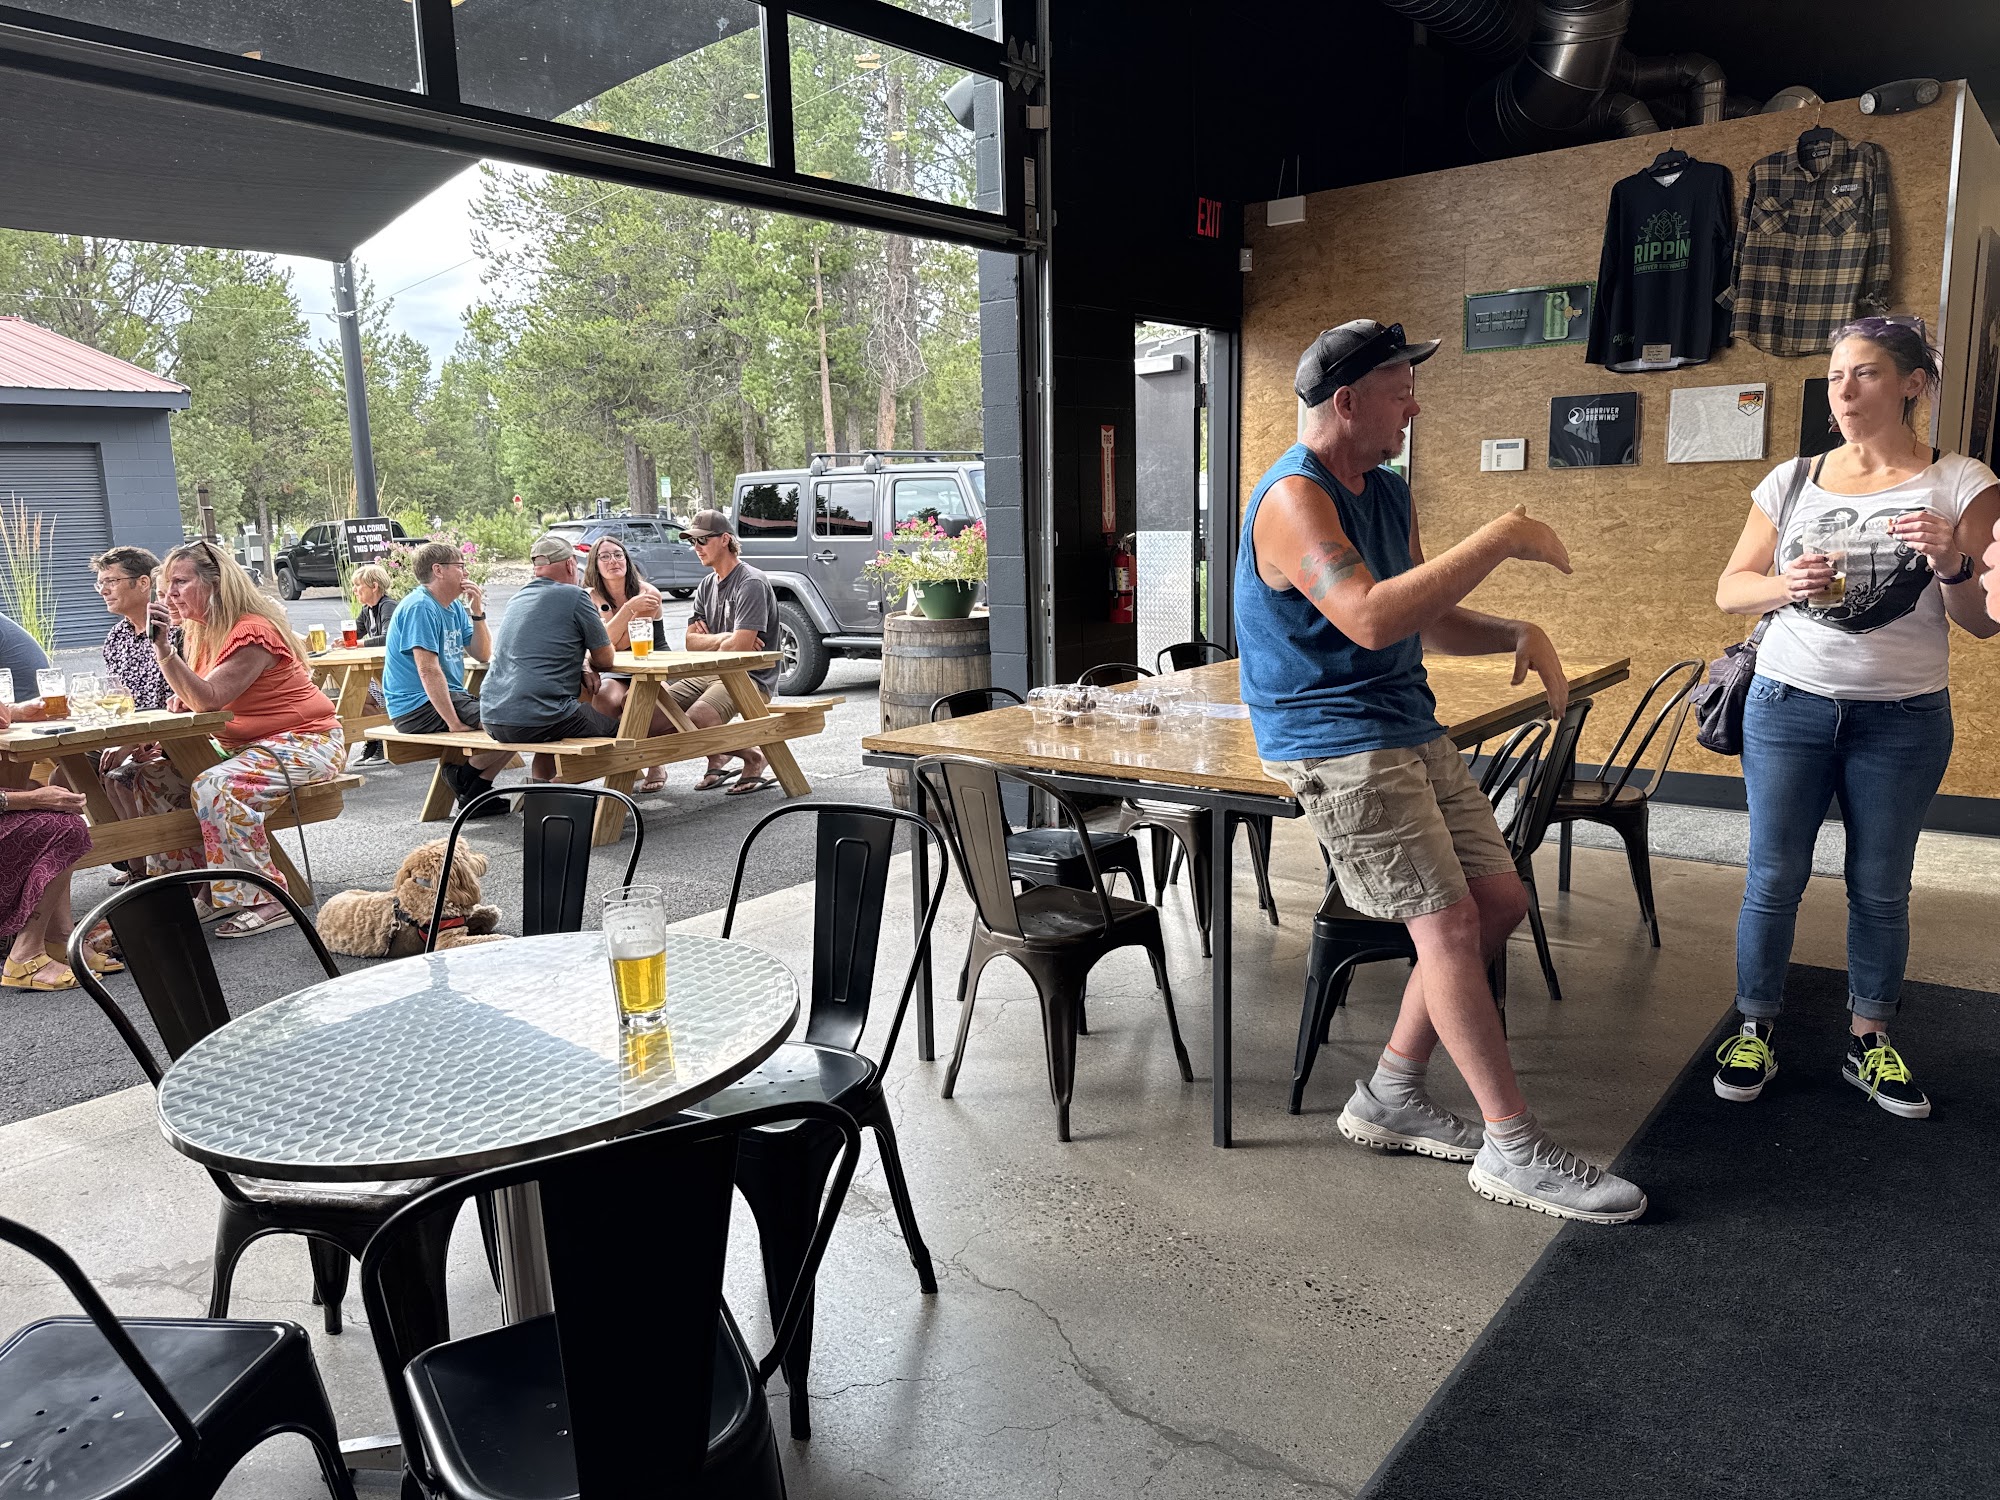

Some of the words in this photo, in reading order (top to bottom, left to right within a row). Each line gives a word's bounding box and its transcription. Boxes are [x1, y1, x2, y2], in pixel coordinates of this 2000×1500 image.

[1198, 197, 1222, 238] EXIT
[1634, 239, 1691, 264] RIPPIN
[347, 525, 357, 534] NO
[359, 523, 388, 533] ALCOHOL
[356, 534, 382, 543] BEYOND
[353, 545, 368, 553] THIS
